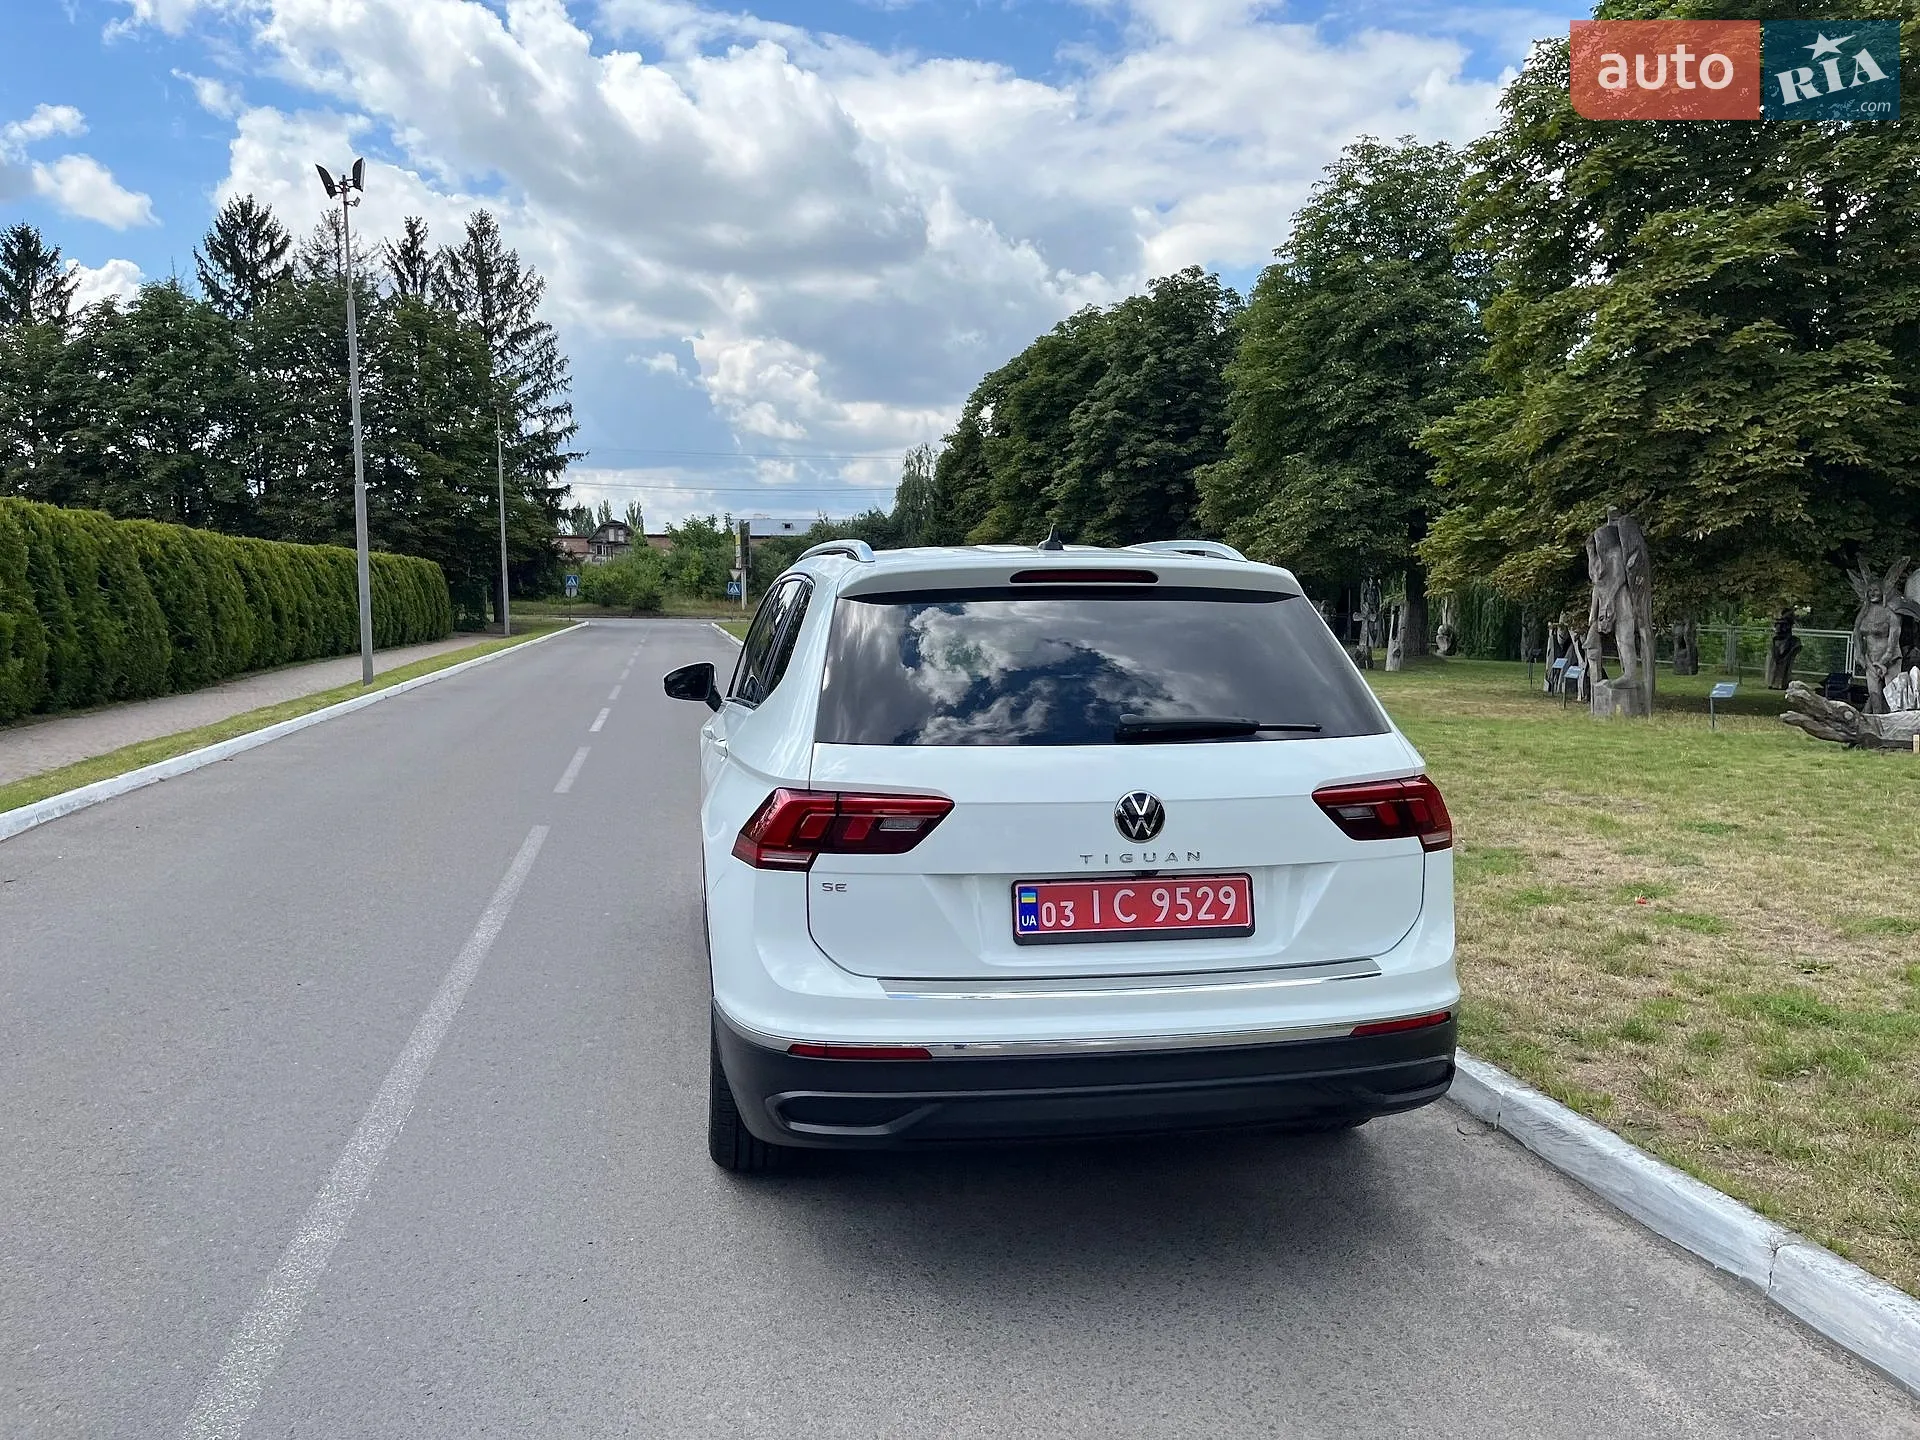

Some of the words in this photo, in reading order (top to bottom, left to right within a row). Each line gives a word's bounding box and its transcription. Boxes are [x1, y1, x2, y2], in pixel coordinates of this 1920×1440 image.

[1079, 851, 1201, 865] TIGUAN
[821, 882, 848, 893] SE
[1041, 901, 1075, 927] 03
[1151, 885, 1236, 923] 9529
[1021, 914, 1037, 927] UA
